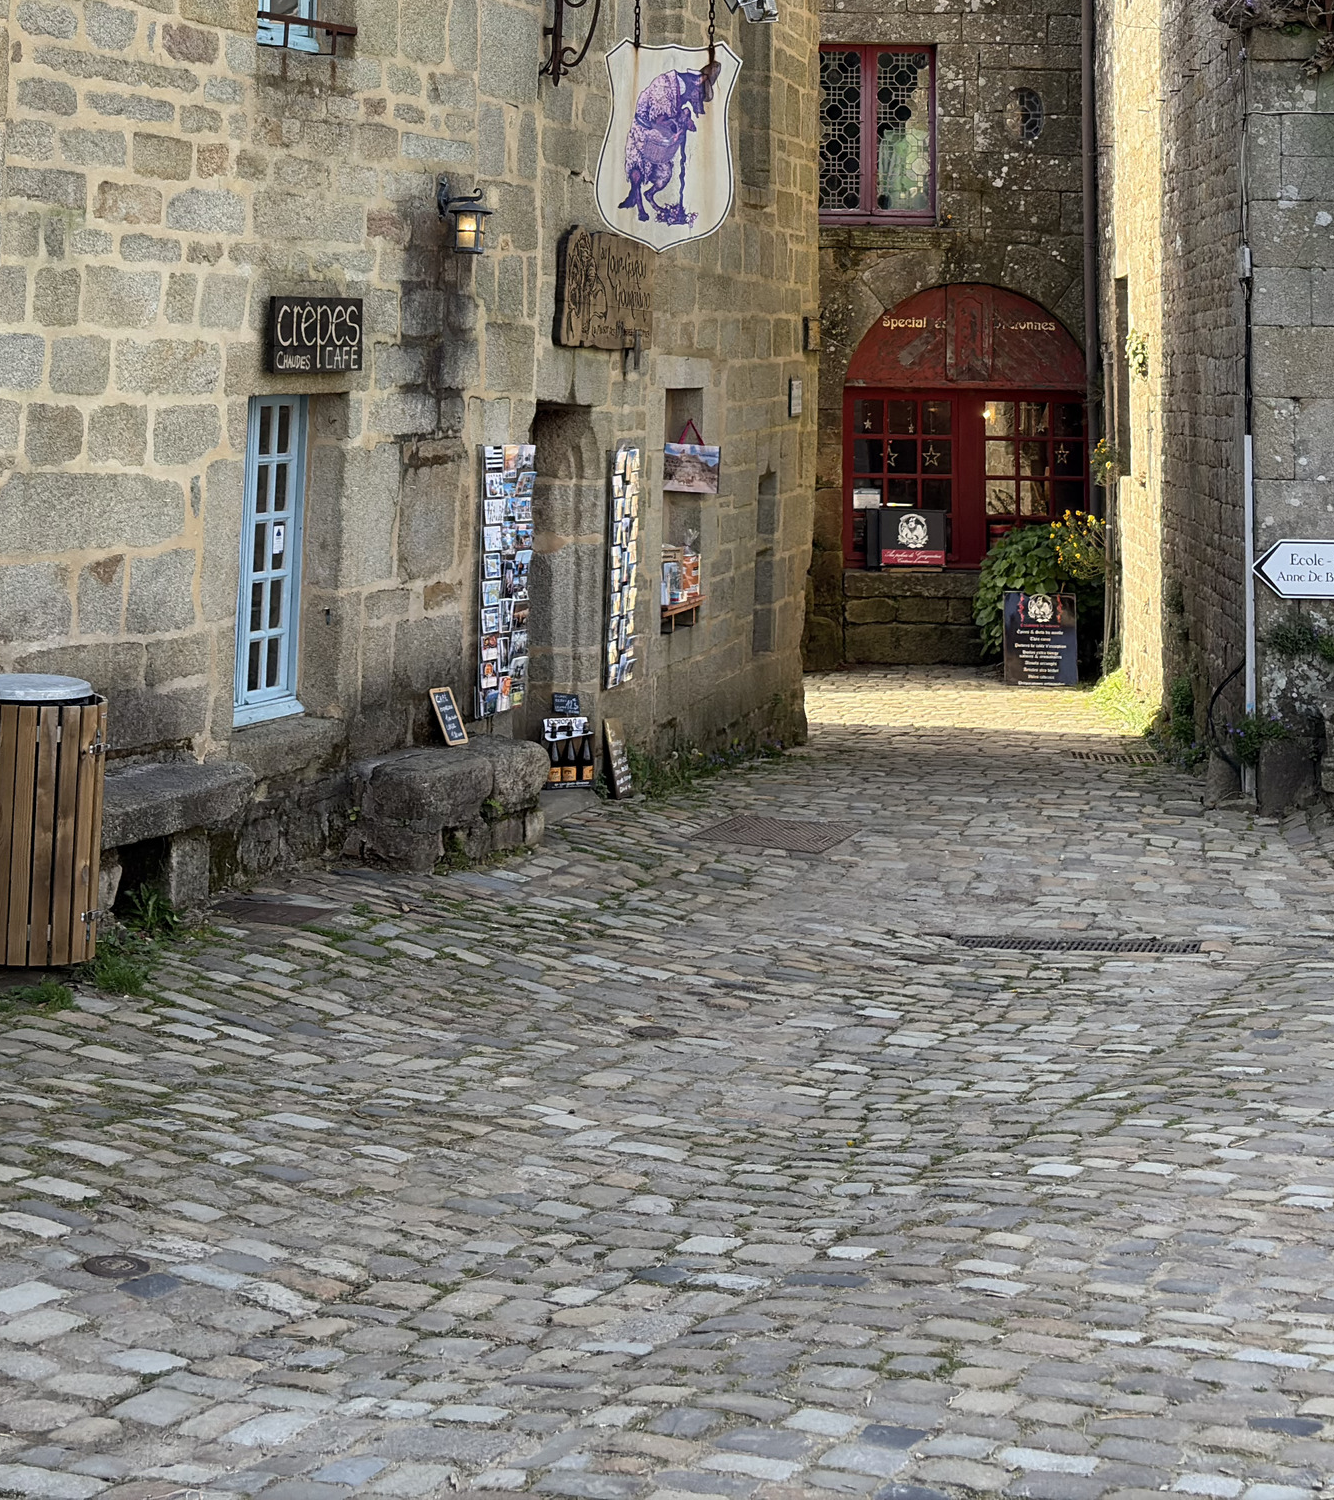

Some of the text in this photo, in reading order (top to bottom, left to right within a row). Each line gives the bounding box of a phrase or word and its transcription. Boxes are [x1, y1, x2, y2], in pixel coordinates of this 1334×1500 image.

[882, 315, 947, 330] Specialés
[277, 301, 360, 369] crêpes
[1290, 553, 1324, 566] Ecole
[1276, 571, 1306, 582] Anne
[1308, 570, 1323, 582] De
